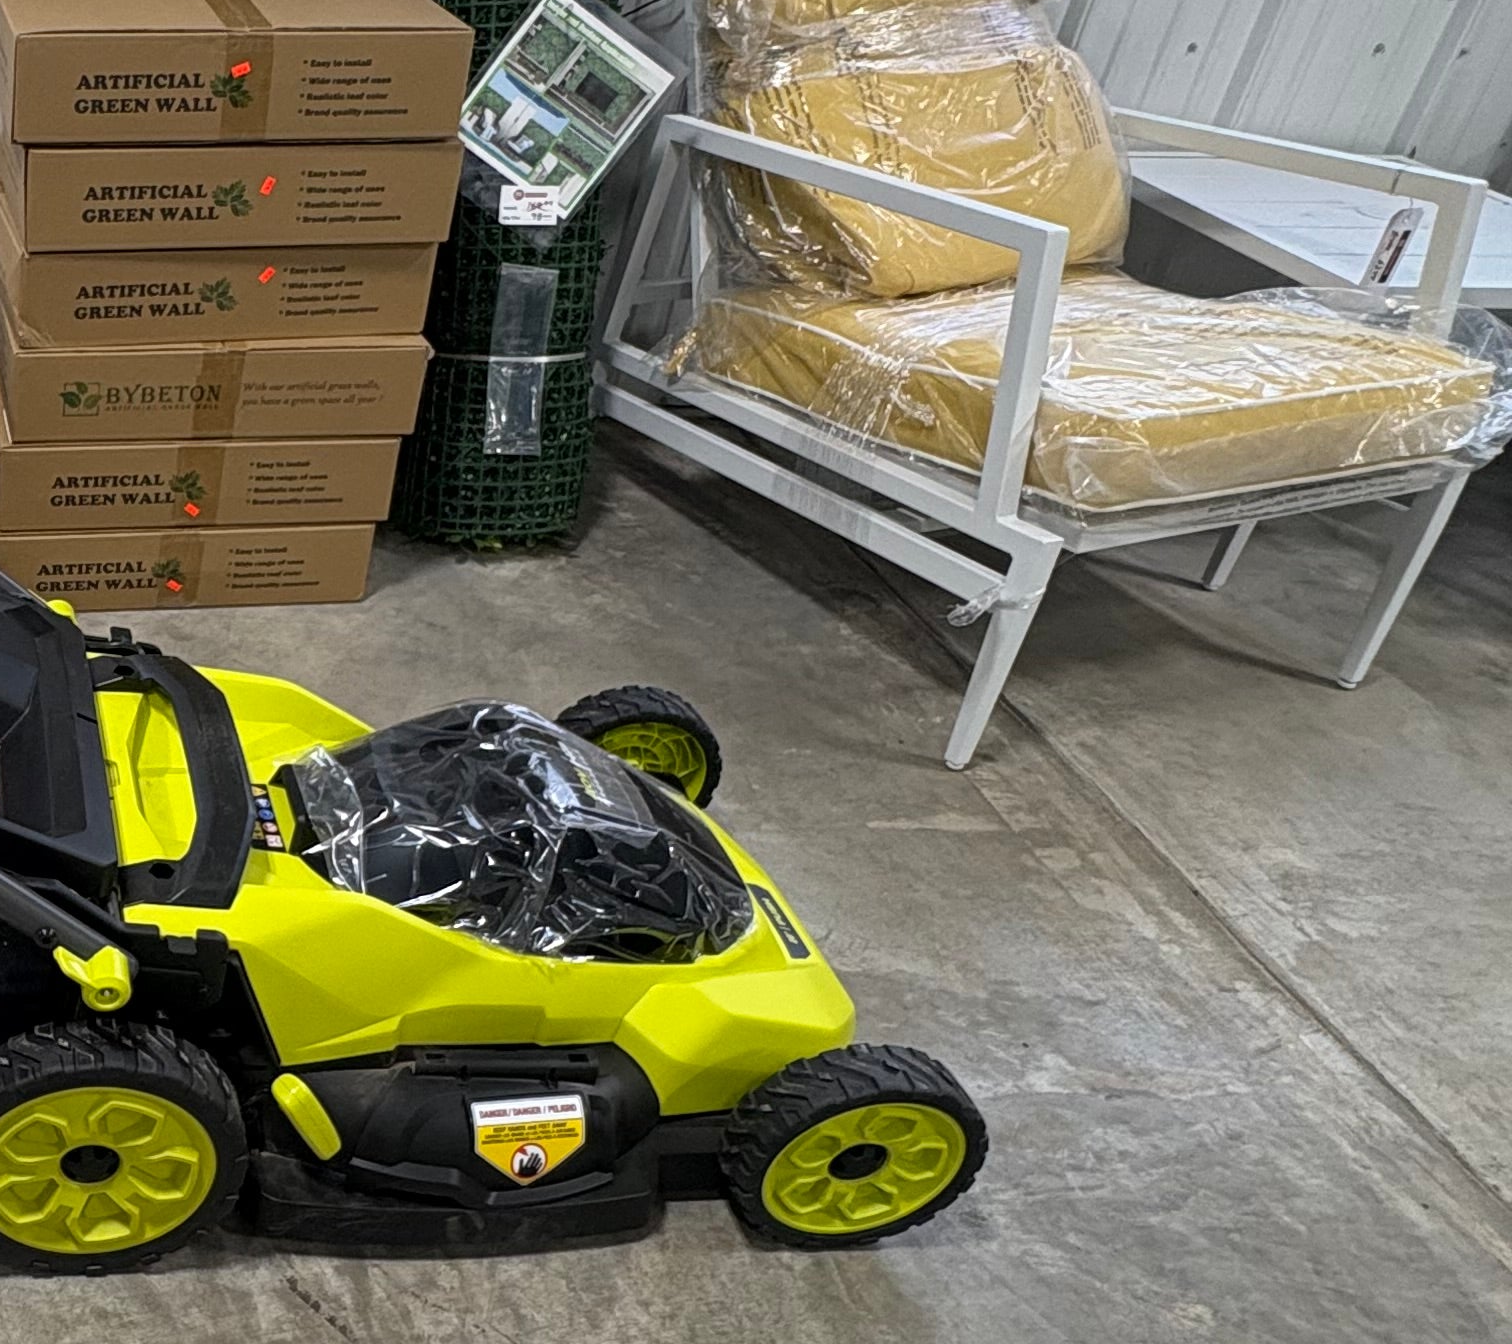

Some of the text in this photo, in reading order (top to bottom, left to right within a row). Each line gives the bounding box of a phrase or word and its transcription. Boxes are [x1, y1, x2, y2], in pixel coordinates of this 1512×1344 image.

[310, 59, 331, 68] Easy
[333, 59, 342, 67] to
[75, 73, 205, 90] ARTIFICIAL
[74, 98, 217, 114] GREEN WALL
[83, 185, 208, 201] ARTIFICIAL
[82, 207, 219, 224] GREEN WALL
[75, 282, 194, 299] ARTIFICIAL
[74, 302, 206, 320] GREEN WALL
[105, 384, 222, 404] BYBETON
[243, 382, 267, 391] With
[51, 473, 165, 490] ARTIFICIAL
[50, 492, 176, 507] GREEN WALL
[37, 561, 147, 577] ARTIFICIAL
[36, 578, 158, 592] GREEN WALL
